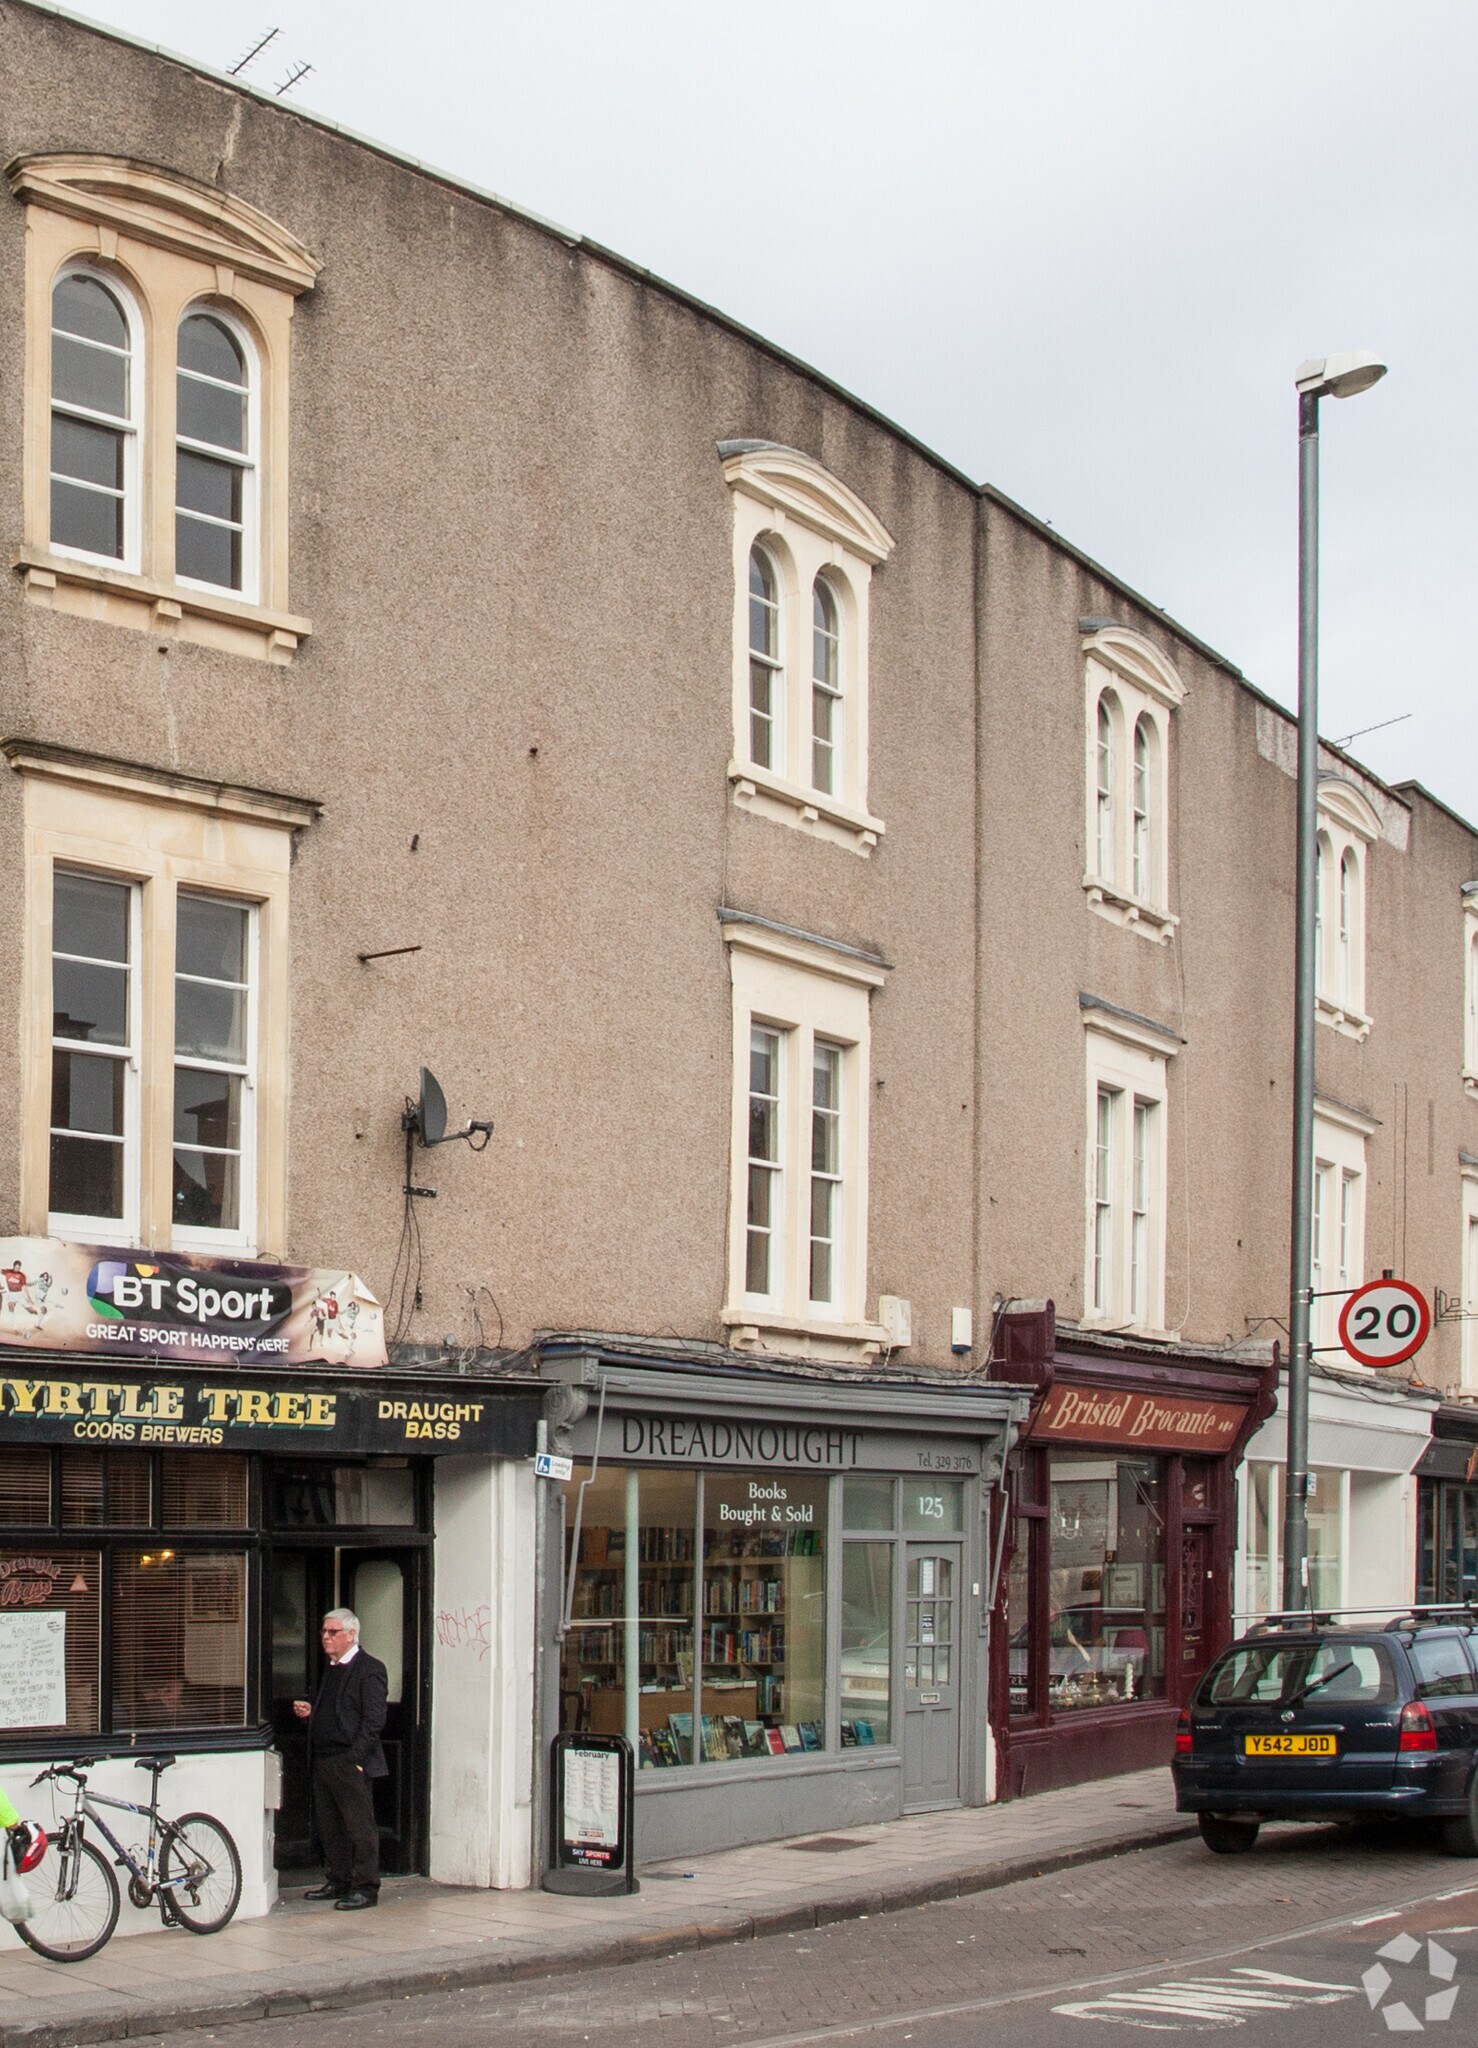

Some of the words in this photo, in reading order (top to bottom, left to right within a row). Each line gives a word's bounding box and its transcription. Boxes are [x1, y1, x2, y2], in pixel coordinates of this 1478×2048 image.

[113, 1275, 171, 1310] BT
[177, 1278, 274, 1322] Sport
[1353, 1303, 1417, 1341] 20
[86, 1324, 135, 1342] GREAT
[139, 1328, 188, 1346] SPORT
[191, 1333, 256, 1352] HAPPENS
[256, 1338, 290, 1353] HERE
[0, 1379, 185, 1424] YRTLE
[198, 1387, 337, 1429] TREE
[378, 1401, 484, 1422] DRAUGHT
[1050, 1391, 1131, 1431] Bristol
[1128, 1400, 1217, 1438] Brocante
[74, 1421, 135, 1440] COORS
[140, 1423, 224, 1444] BREWERS
[405, 1421, 461, 1440] BASS
[621, 1415, 864, 1465] DREADNOUGHT
[935, 1455, 951, 1470] 329
[748, 1481, 788, 1500] Books
[720, 1503, 767, 1526] Bought
[770, 1506, 782, 1522] &
[786, 1504, 813, 1523] Sold
[919, 1496, 944, 1519] 125
[575, 1750, 610, 1761] February
[1252, 1737, 1293, 1752] Y542
[585, 1850, 610, 1859] SPORTS
